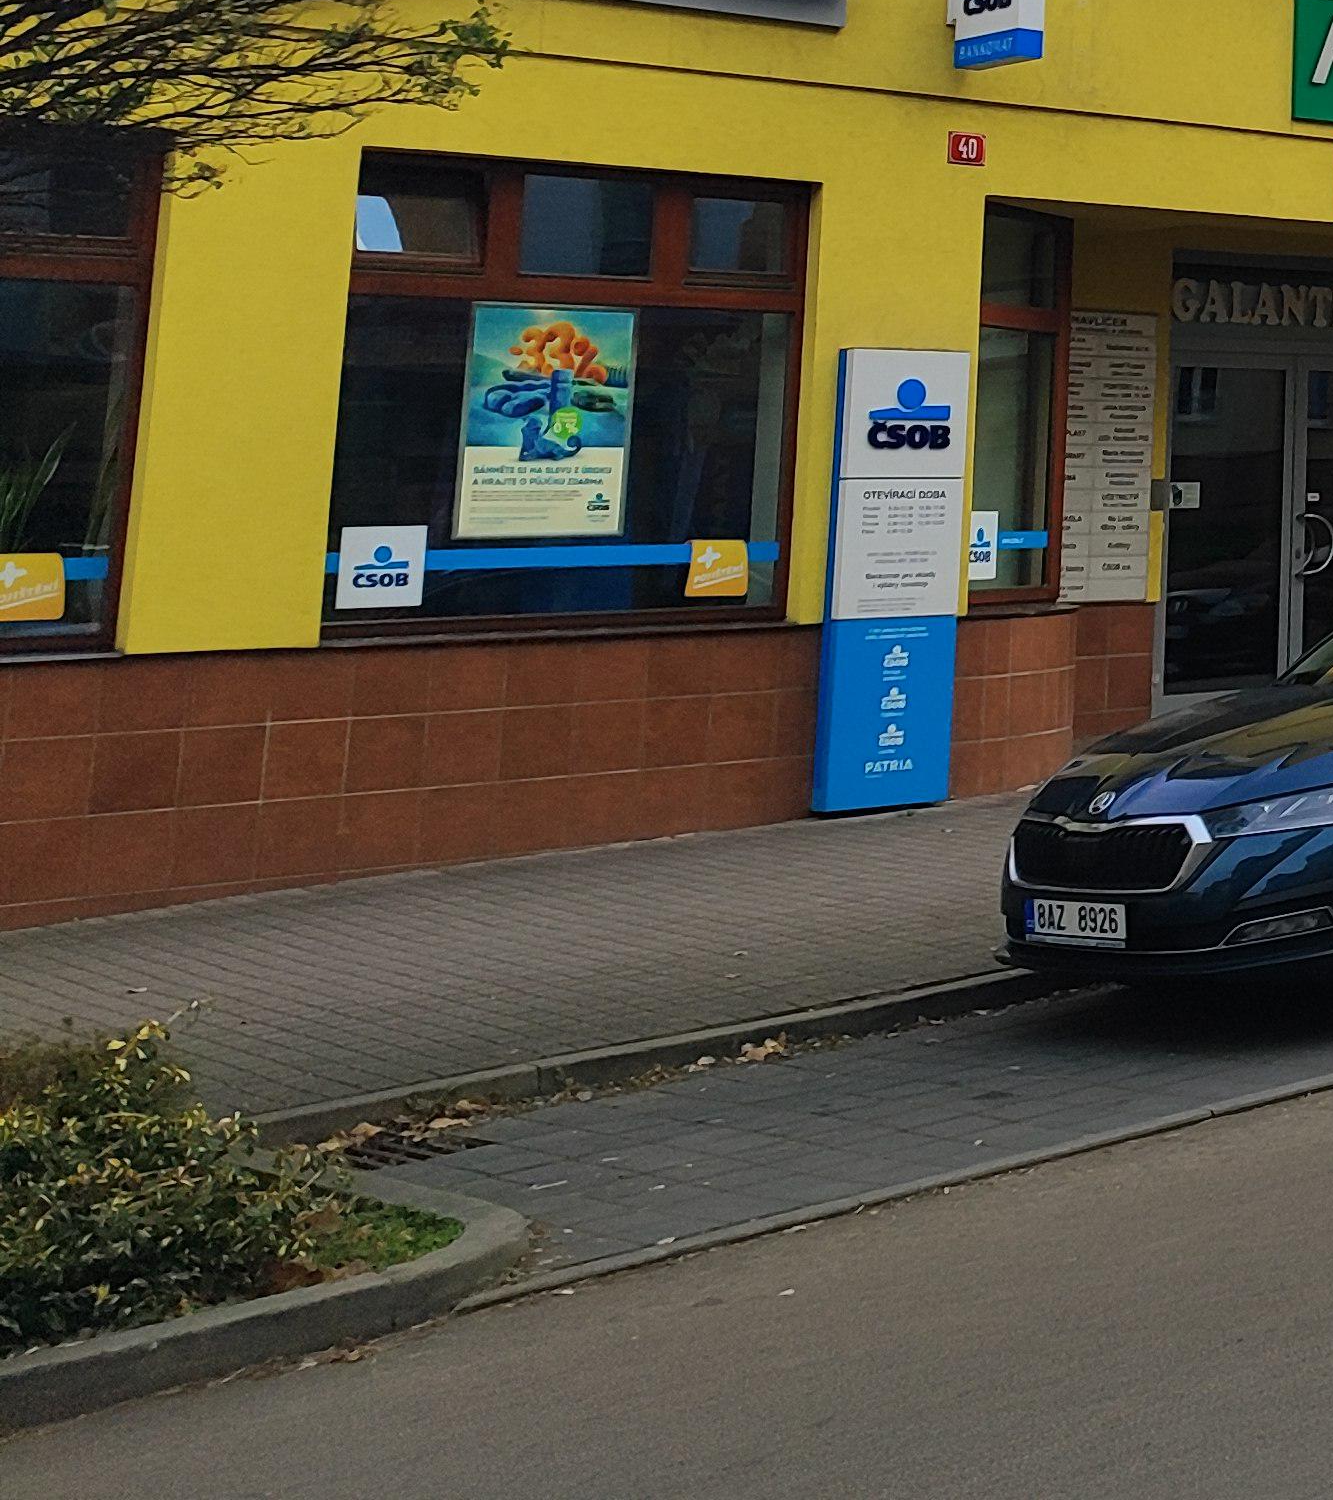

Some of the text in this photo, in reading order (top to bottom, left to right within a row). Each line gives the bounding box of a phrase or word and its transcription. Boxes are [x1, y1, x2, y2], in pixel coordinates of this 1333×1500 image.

[957, 136, 978, 160] 40
[867, 420, 951, 450] ČSOB
[918, 490, 947, 500] DOBA
[864, 758, 914, 774] PATRIA
[1037, 903, 1119, 934] 8AZ 8926
